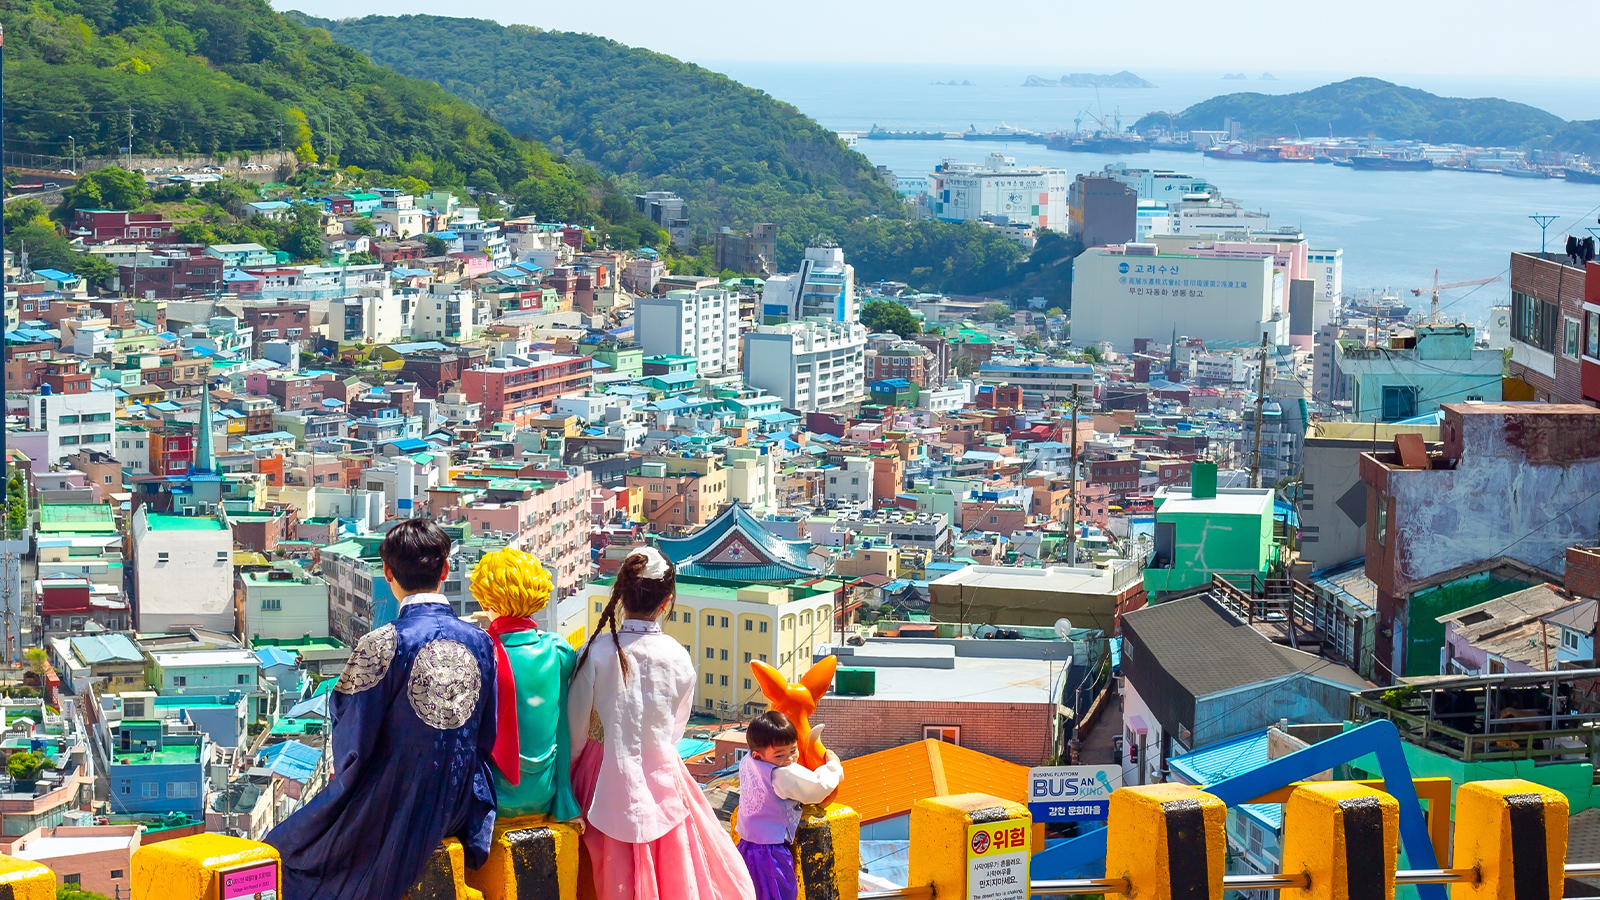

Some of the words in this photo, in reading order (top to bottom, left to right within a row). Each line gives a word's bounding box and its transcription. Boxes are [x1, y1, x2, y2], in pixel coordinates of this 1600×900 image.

[1135, 265, 1179, 275] 고려수산
[1325, 266, 1333, 298] 대한수산
[1033, 778, 1079, 797] BUS
[1080, 778, 1095, 786] AN
[1080, 787, 1103, 796] KING
[1048, 807, 1066, 816] 감천
[1068, 805, 1101, 815] 문화마을
[993, 827, 1025, 849] 위험
[974, 861, 999, 870] 사막여우가
[986, 868, 1011, 877] 사막여우를
